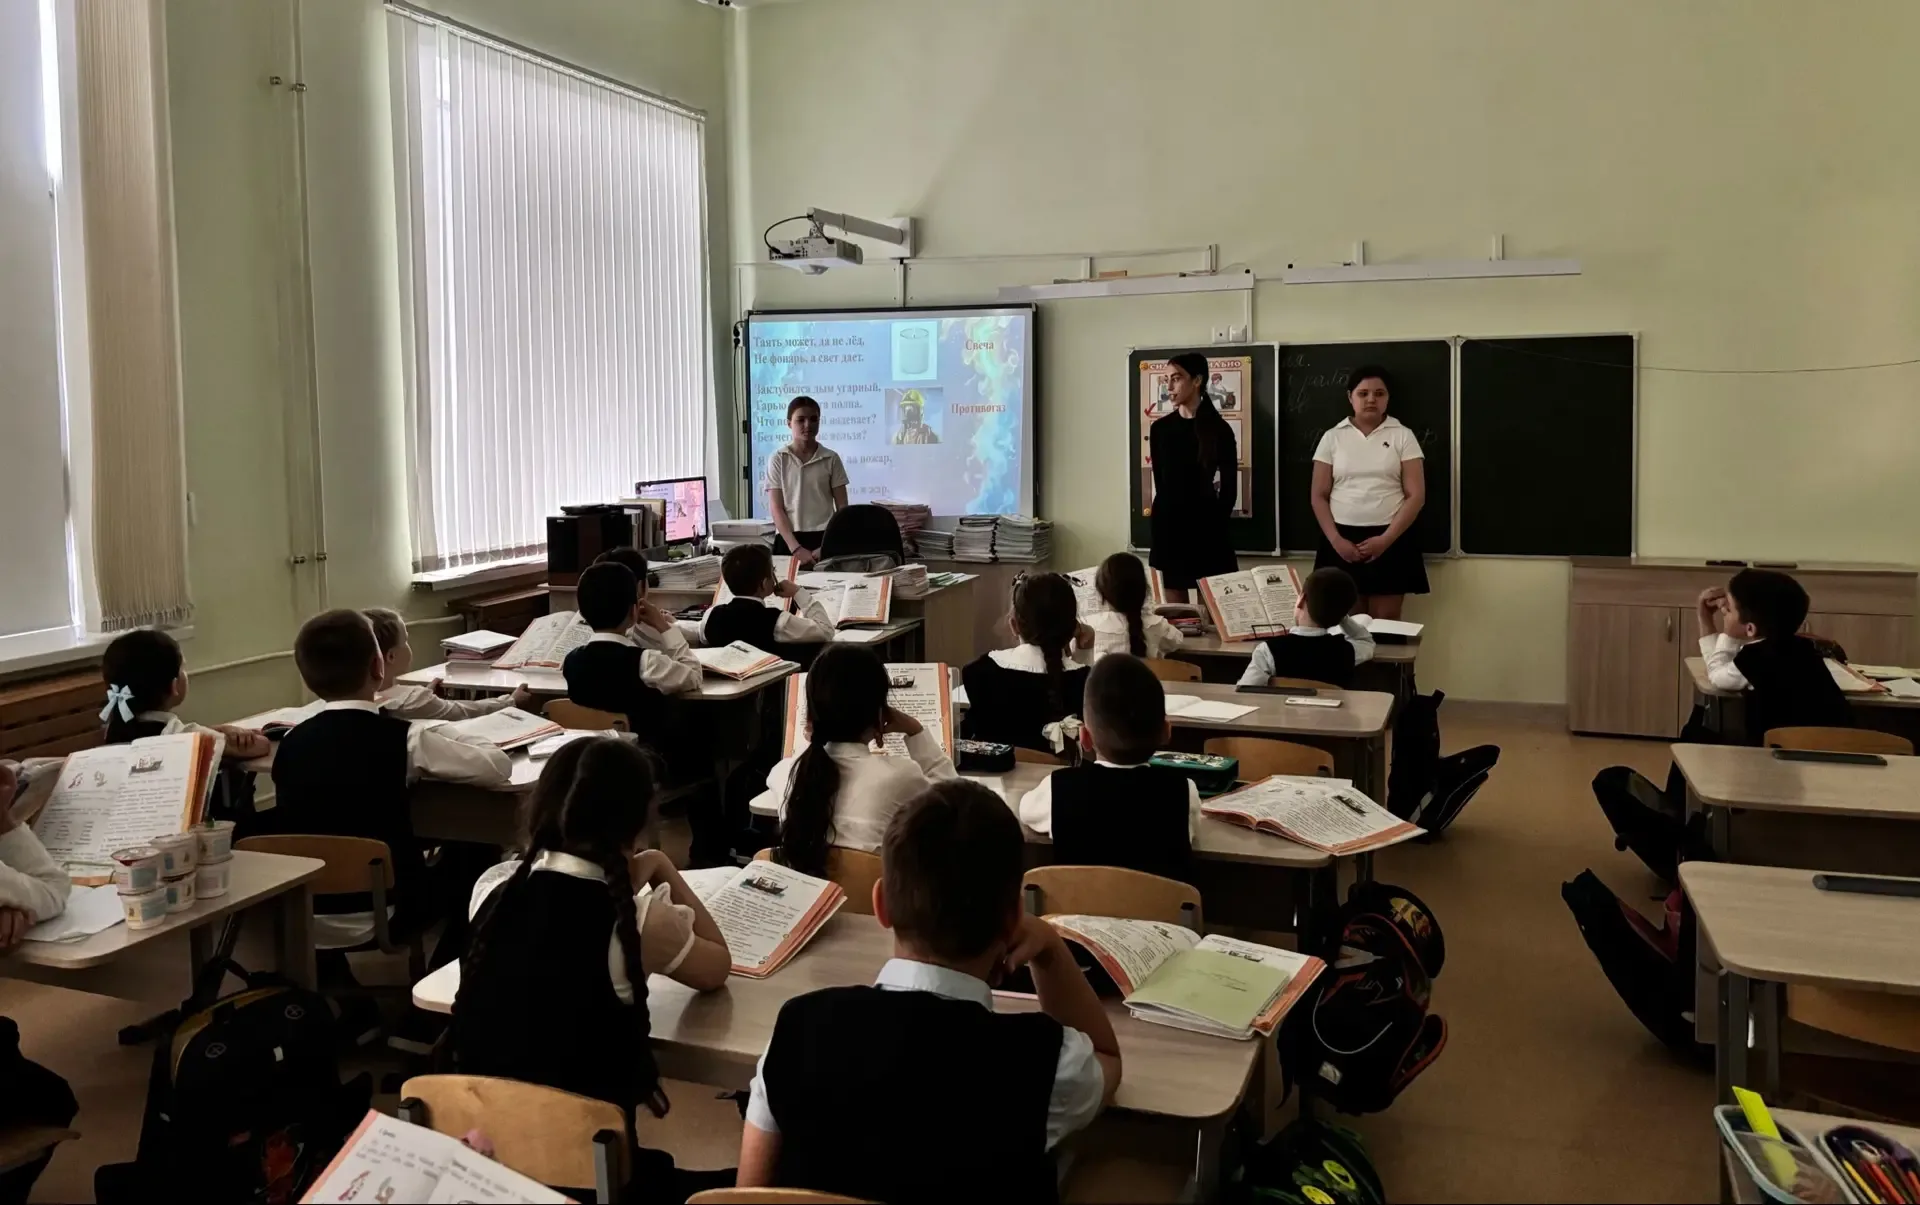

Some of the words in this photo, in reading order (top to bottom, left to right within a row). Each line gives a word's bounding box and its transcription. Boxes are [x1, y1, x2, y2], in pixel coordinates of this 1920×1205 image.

[753, 336, 782, 348] Таять
[832, 337, 843, 346] не
[965, 339, 994, 350] Свеча
[754, 353, 767, 364] Не
[810, 355, 816, 363] а
[818, 354, 838, 363] свет
[1208, 360, 1242, 369] ИЛЬНО
[951, 403, 1006, 416] Противогаз
